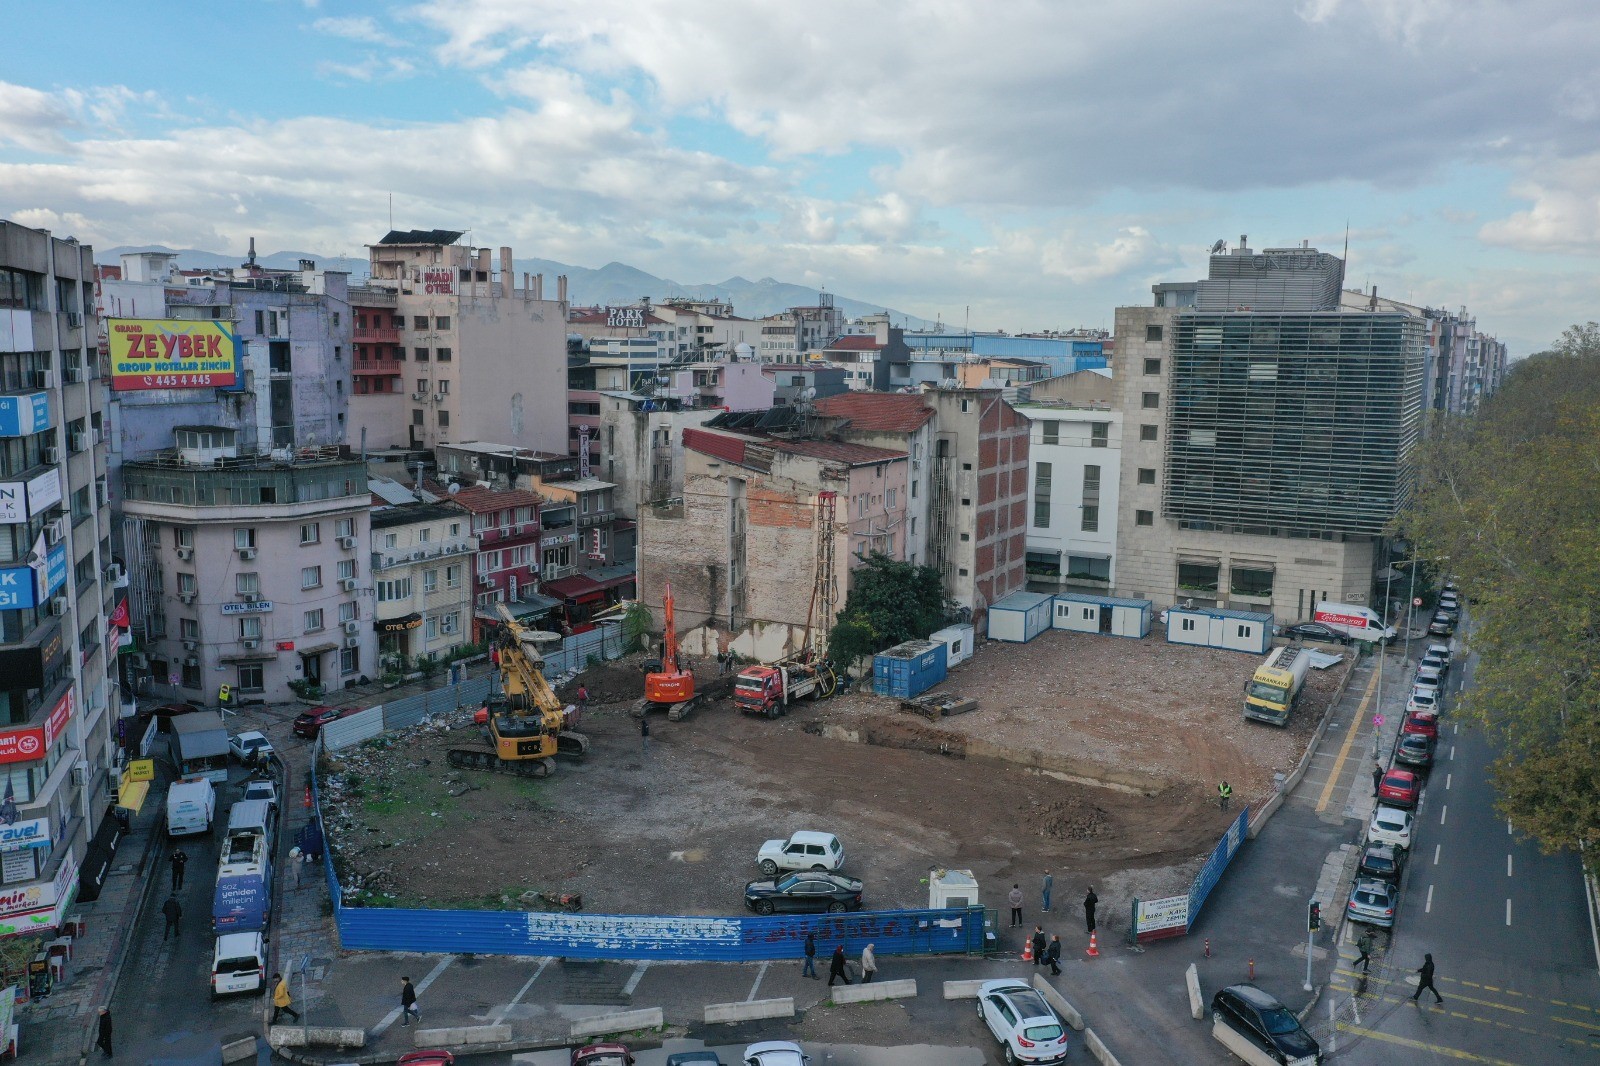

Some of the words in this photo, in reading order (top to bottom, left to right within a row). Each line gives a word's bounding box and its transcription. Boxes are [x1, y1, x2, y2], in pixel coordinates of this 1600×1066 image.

[425, 283, 454, 295] OTEL
[609, 308, 644, 319] PARK
[606, 317, 646, 328] HOTEL
[114, 324, 143, 333] GRAND
[126, 333, 223, 359] ZEYBEK
[117, 362, 152, 373] GROUP
[154, 361, 199, 372] HOTELLER
[200, 358, 231, 371] ZİNCİRİ
[155, 375, 177, 386] 445
[181, 375, 187, 385] 4
[191, 374, 211, 385] 445
[385, 623, 405, 631] OTEL
[1254, 675, 1288, 687] BARANKAYA
[222, 882, 238, 890] söz
[221, 888, 257, 899] yeniden
[222, 895, 254, 905] milletin!
